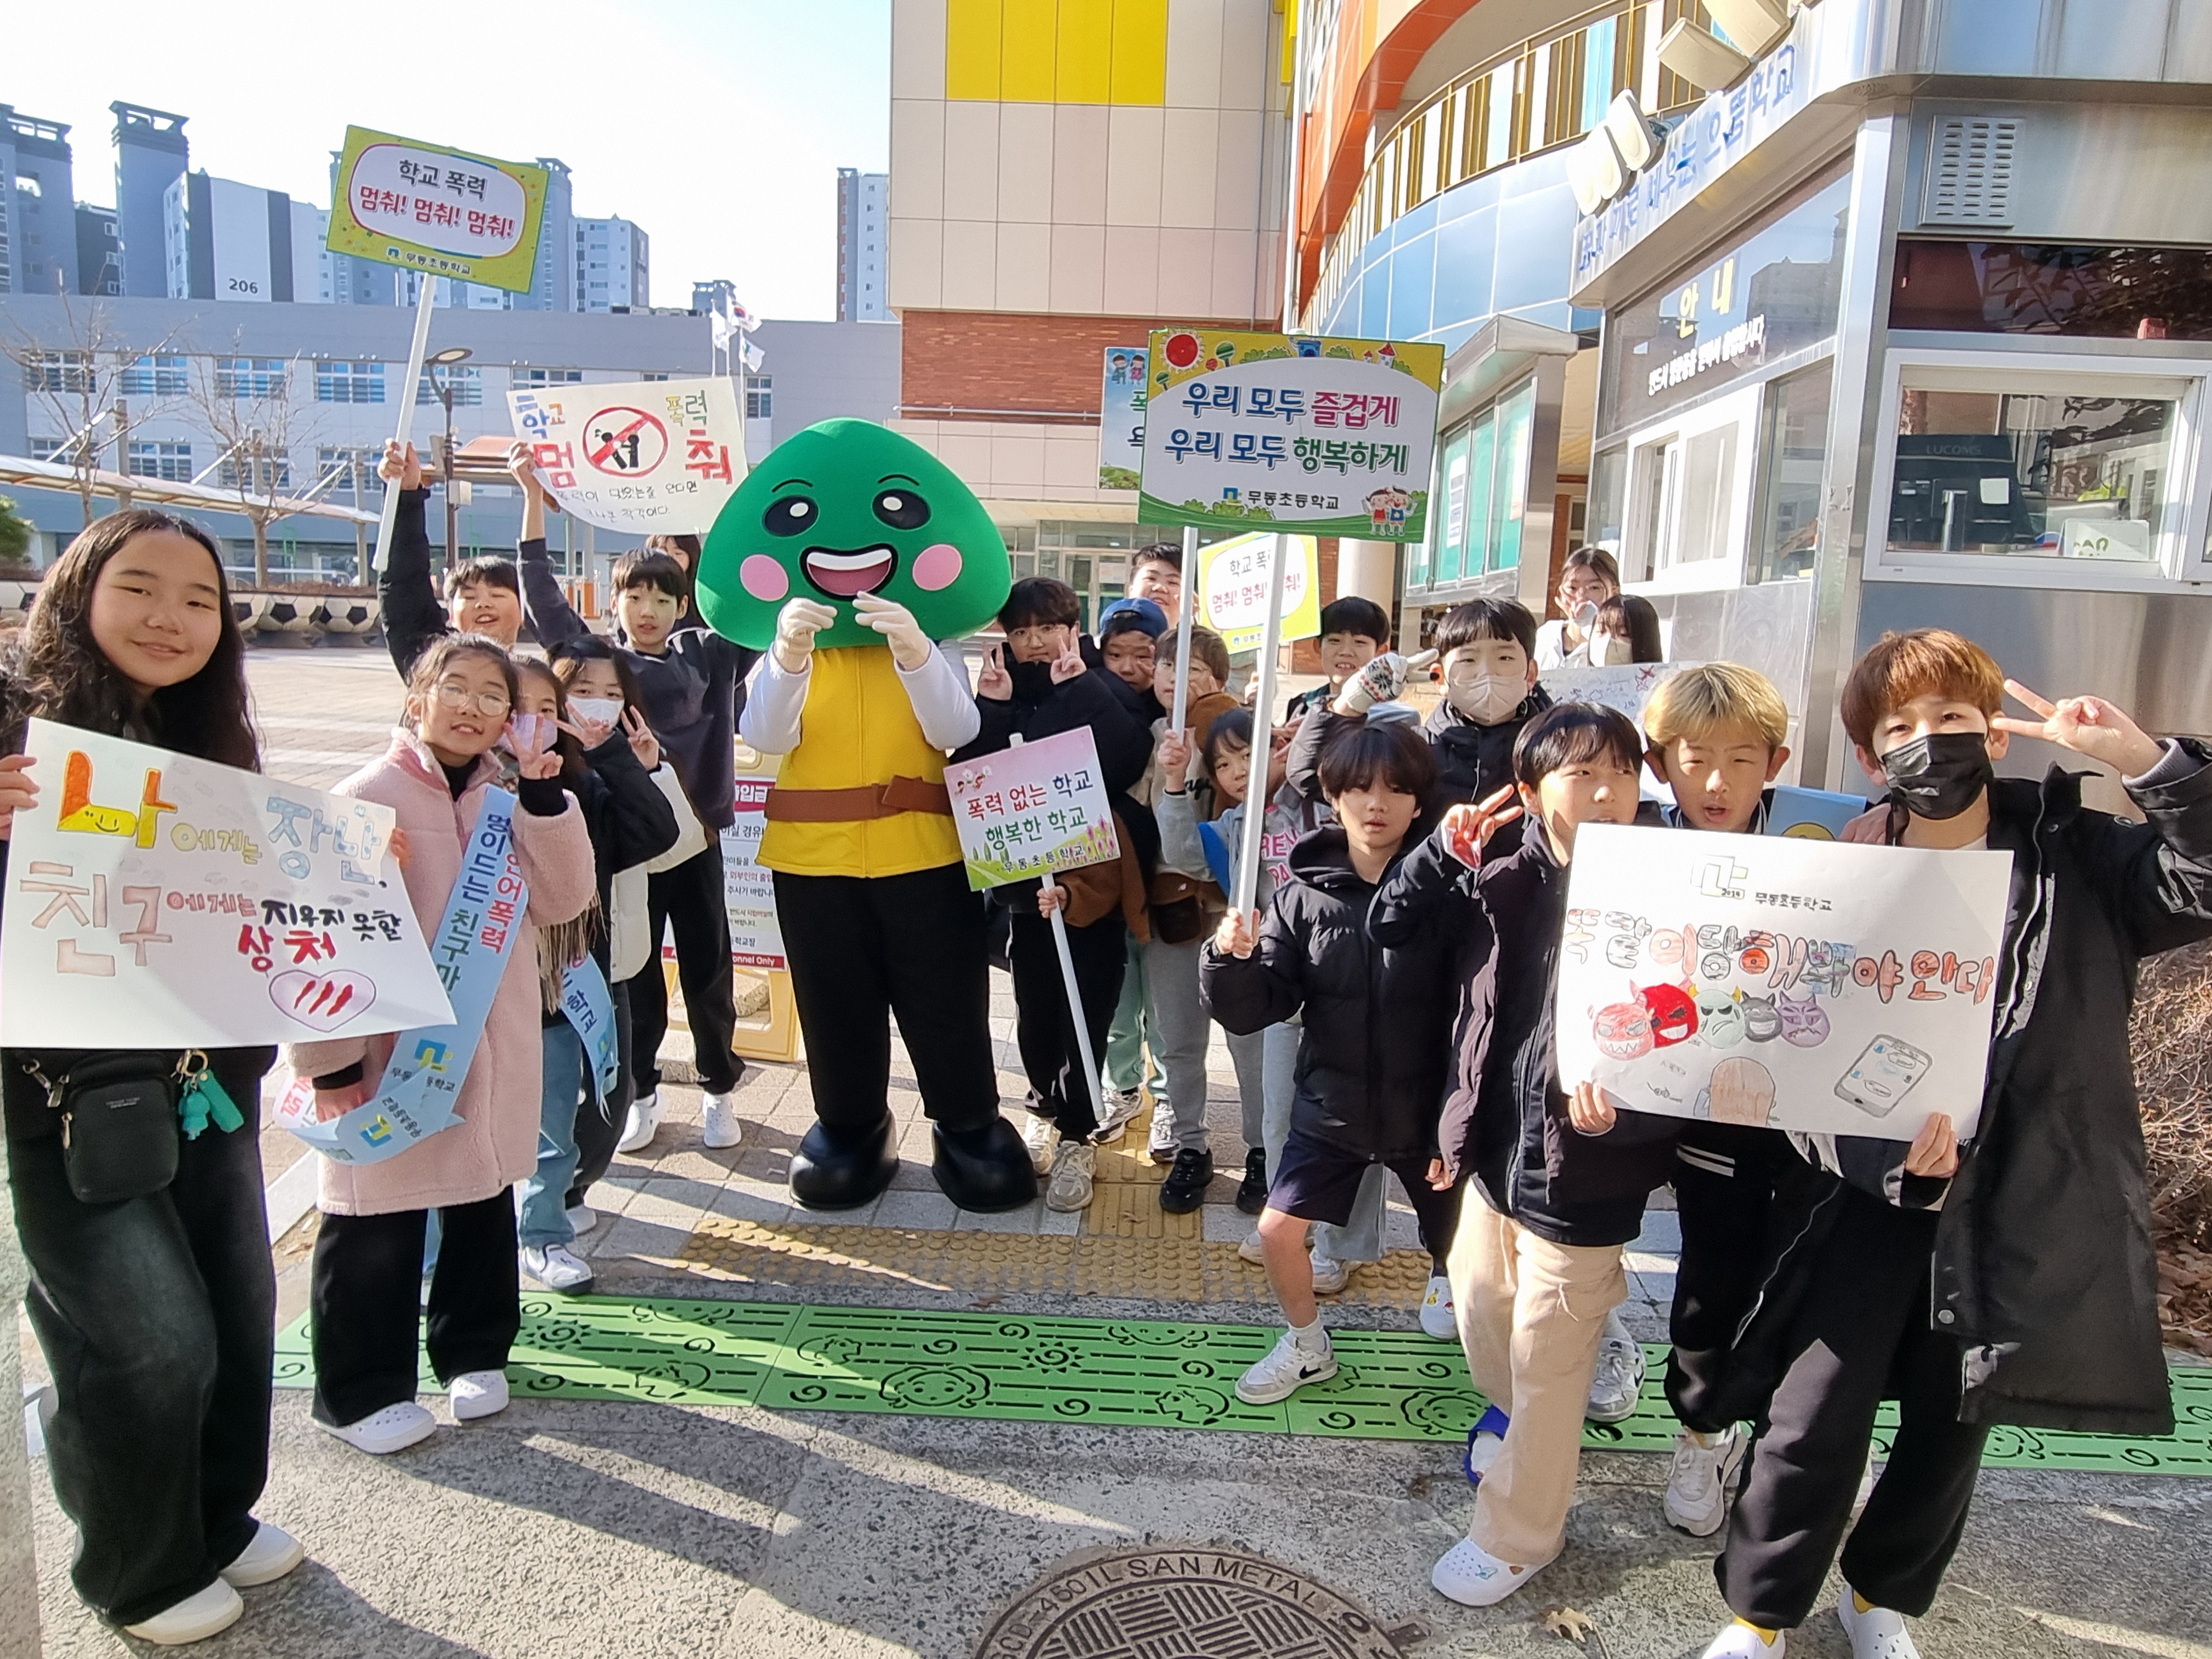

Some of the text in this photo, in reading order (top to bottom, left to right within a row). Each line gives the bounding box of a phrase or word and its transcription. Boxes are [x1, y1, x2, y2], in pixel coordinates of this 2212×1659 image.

[399, 160, 487, 200] 학교 폭력
[360, 186, 515, 238] 멈춰! 멈춰! 멈춰!
[406, 252, 471, 274] 무동초등학교
[228, 277, 258, 295] 206
[515, 390, 708, 439] 학교 폭력
[1182, 382, 1239, 417] 우리
[1246, 388, 1306, 422] 모두
[1311, 391, 1400, 427] 즐겁게
[1165, 428, 1222, 462] 우리
[1228, 434, 1287, 469] 모두
[1293, 436, 1409, 474] 행복하게
[665, 480, 698, 494] 안다면
[1248, 490, 1339, 510] 무동초등학교
[1229, 550, 1271, 577] 학교 폭
[1212, 590, 1238, 613] 멈춰!
[1284, 573, 1300, 592] 춰!
[735, 784, 768, 803] 입금
[967, 770, 1094, 821] 폭력 없는 학교
[742, 826, 764, 838] 경유
[985, 806, 1088, 851] 행복한 학교
[1004, 845, 1085, 873] 무동초등학교
[730, 871, 758, 883] 외부인의
[1755, 892, 1832, 911] 무동초등학교
[262, 900, 345, 929] 지우지
[351, 909, 403, 942] 못할
[237, 924, 336, 974] 상처
[436, 909, 479, 992] 친구마
[731, 936, 756, 947] 학교장
[733, 955, 775, 967] onnel Only
[1127, 1556, 1201, 1578] SAN
[1212, 1557, 1316, 1609] METAL
